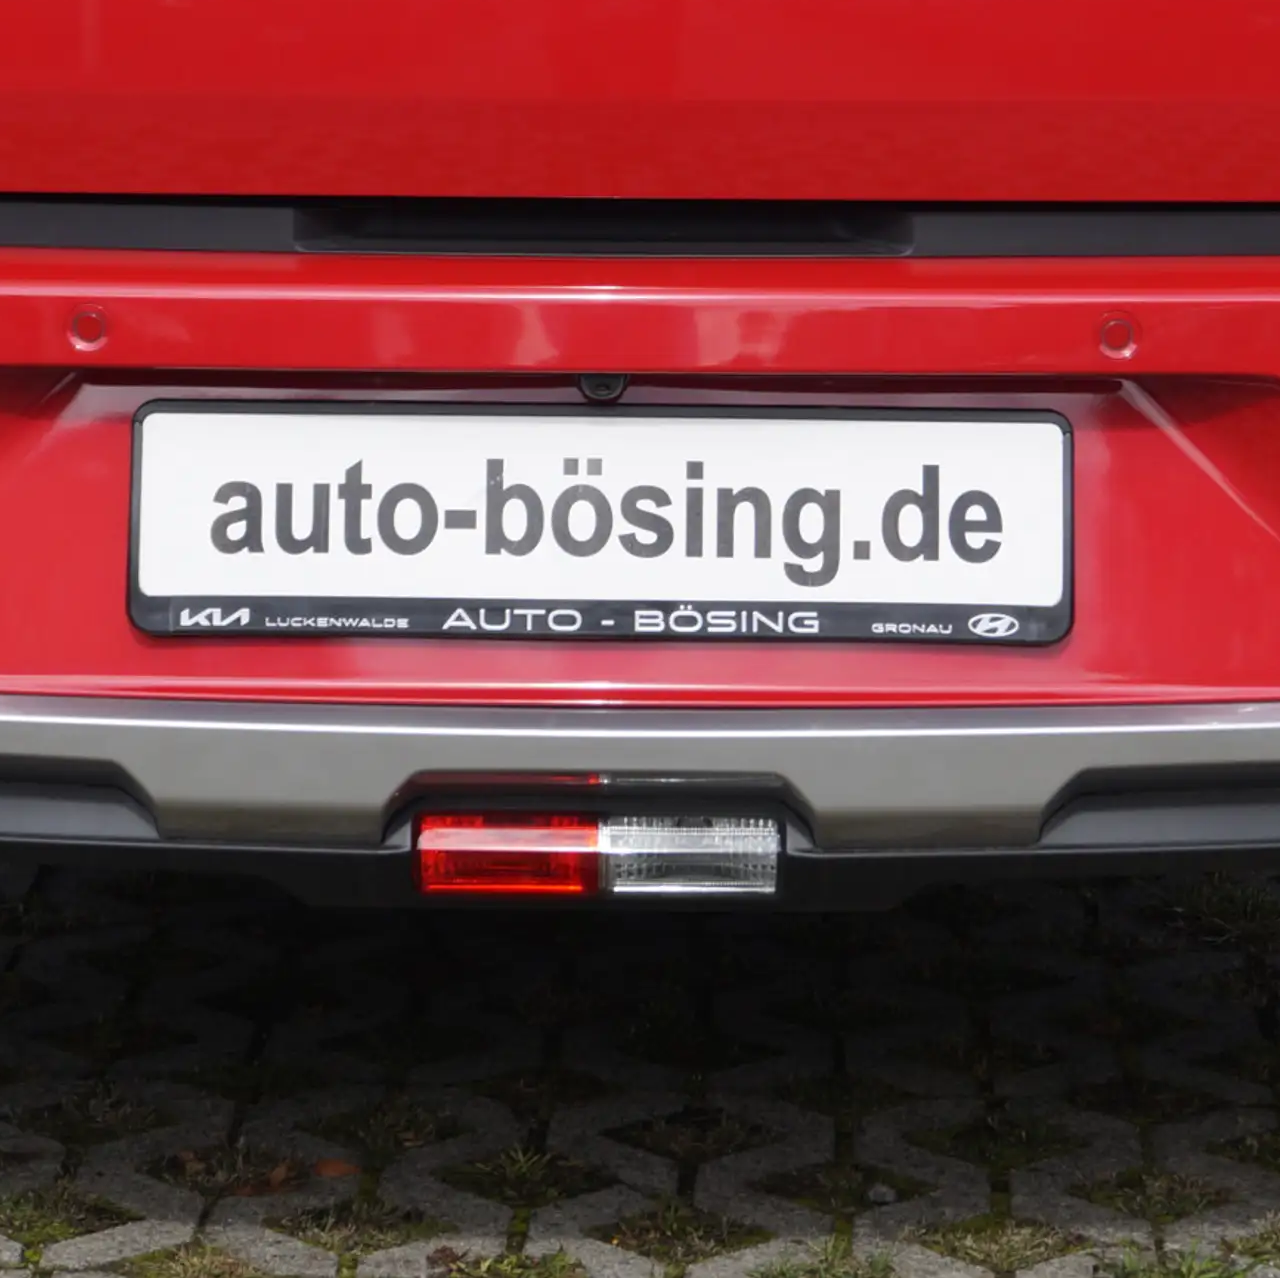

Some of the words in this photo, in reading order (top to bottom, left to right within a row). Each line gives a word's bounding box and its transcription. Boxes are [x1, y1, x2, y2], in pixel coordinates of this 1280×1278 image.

[210, 456, 1004, 587] auto-bösing.de
[264, 616, 410, 629] LUCKENWALDE
[441, 608, 583, 632] AUTO
[634, 605, 820, 634] BÖSING
[871, 622, 953, 635] GRONAU
